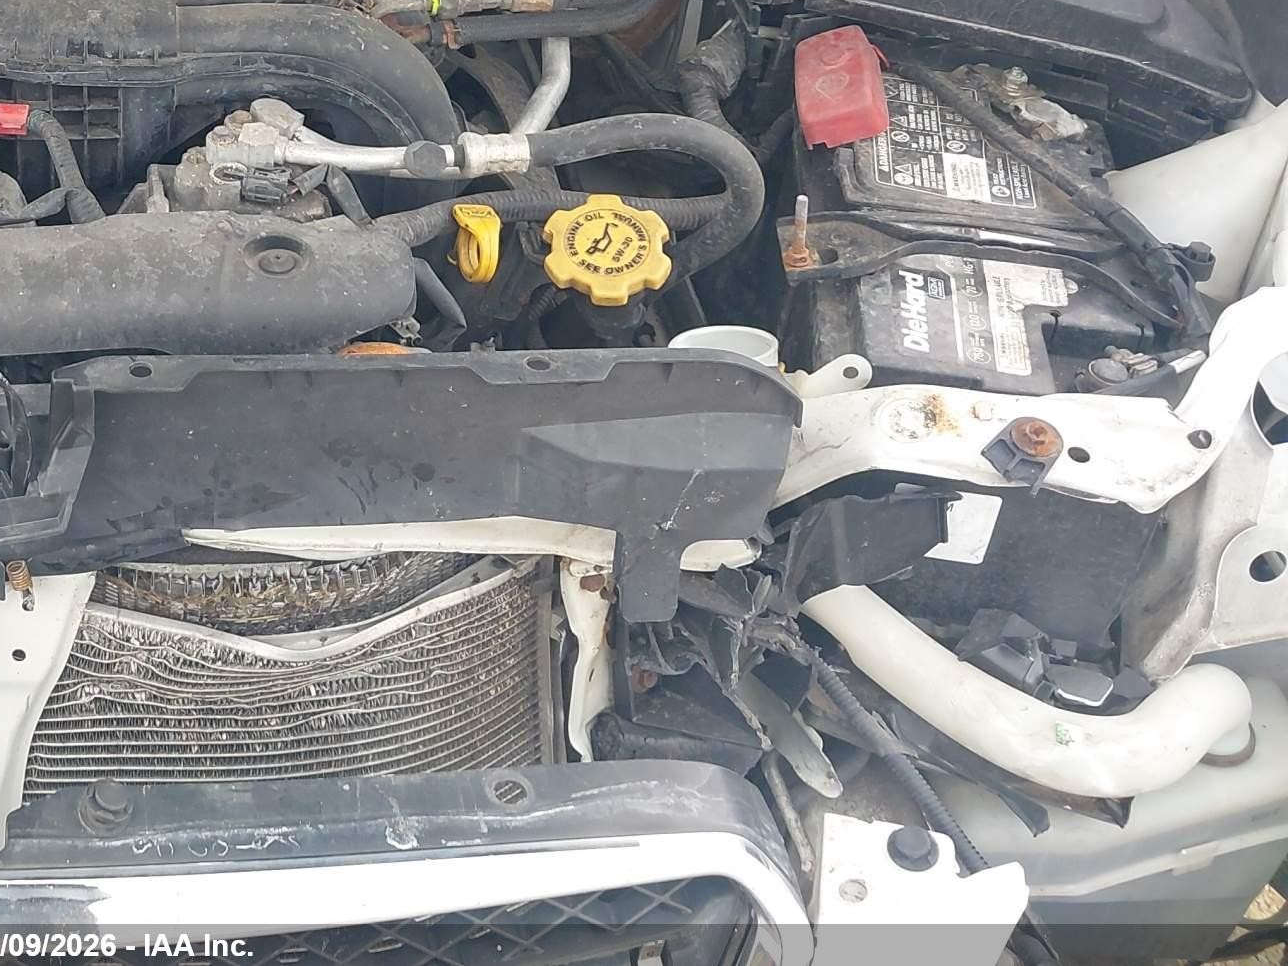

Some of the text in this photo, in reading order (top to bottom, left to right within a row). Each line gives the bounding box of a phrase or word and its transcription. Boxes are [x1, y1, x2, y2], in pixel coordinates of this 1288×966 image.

[567, 212, 604, 256] ENGINE OIL
[579, 212, 647, 274] SEE OWNER'S MANUAL
[612, 236, 633, 263] 5W-30
[899, 270, 930, 353] DieHard
